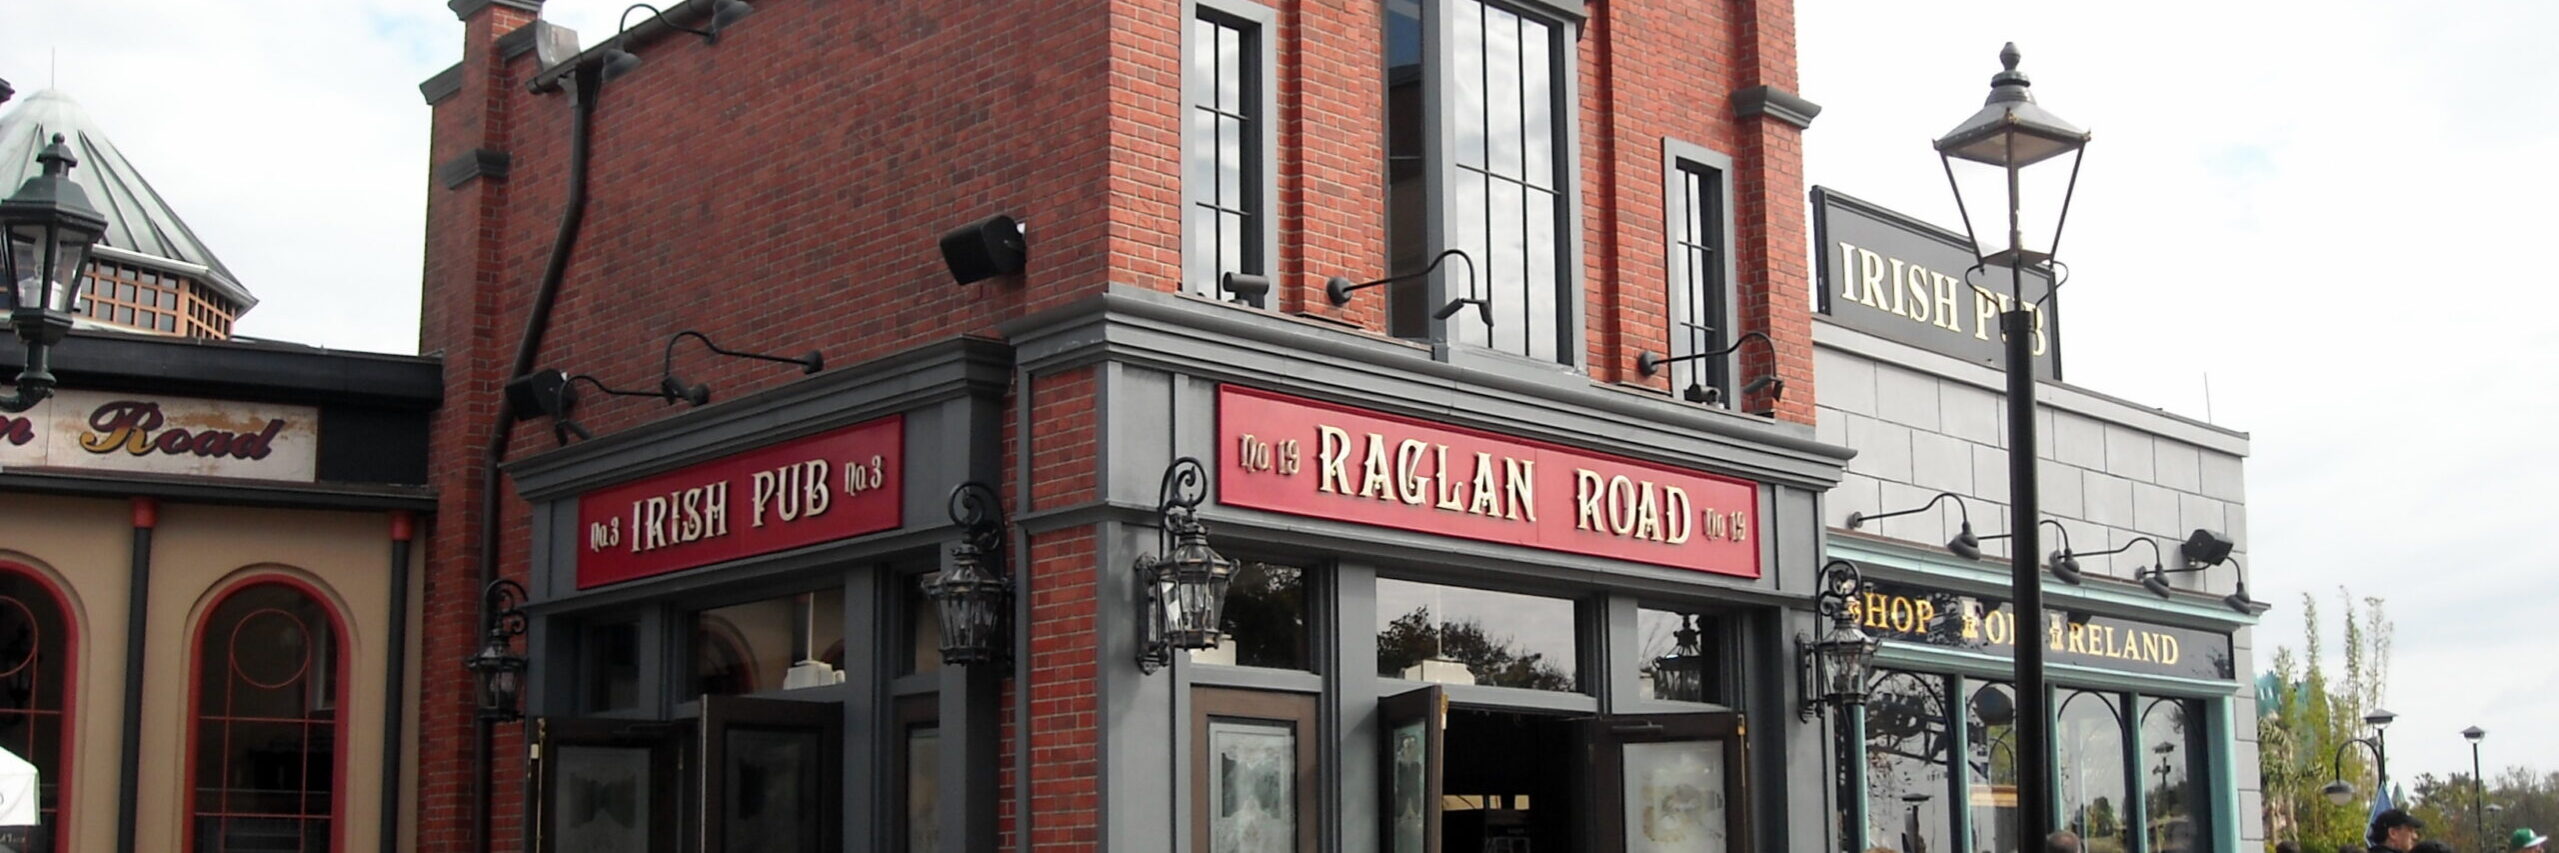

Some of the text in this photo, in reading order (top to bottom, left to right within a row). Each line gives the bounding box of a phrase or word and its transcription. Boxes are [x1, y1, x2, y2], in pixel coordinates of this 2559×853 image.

[1838, 242, 1962, 333] IRISH
[79, 400, 286, 460] Road
[630, 480, 729, 552] IRISH
[751, 458, 830, 528] PUB
[1276, 438, 1300, 475] 19
[1317, 424, 1538, 522] RAGLAN
[1576, 467, 1693, 545] ROAD
[1728, 510, 1746, 542] 19
[2048, 612, 2180, 665] IRELAND
